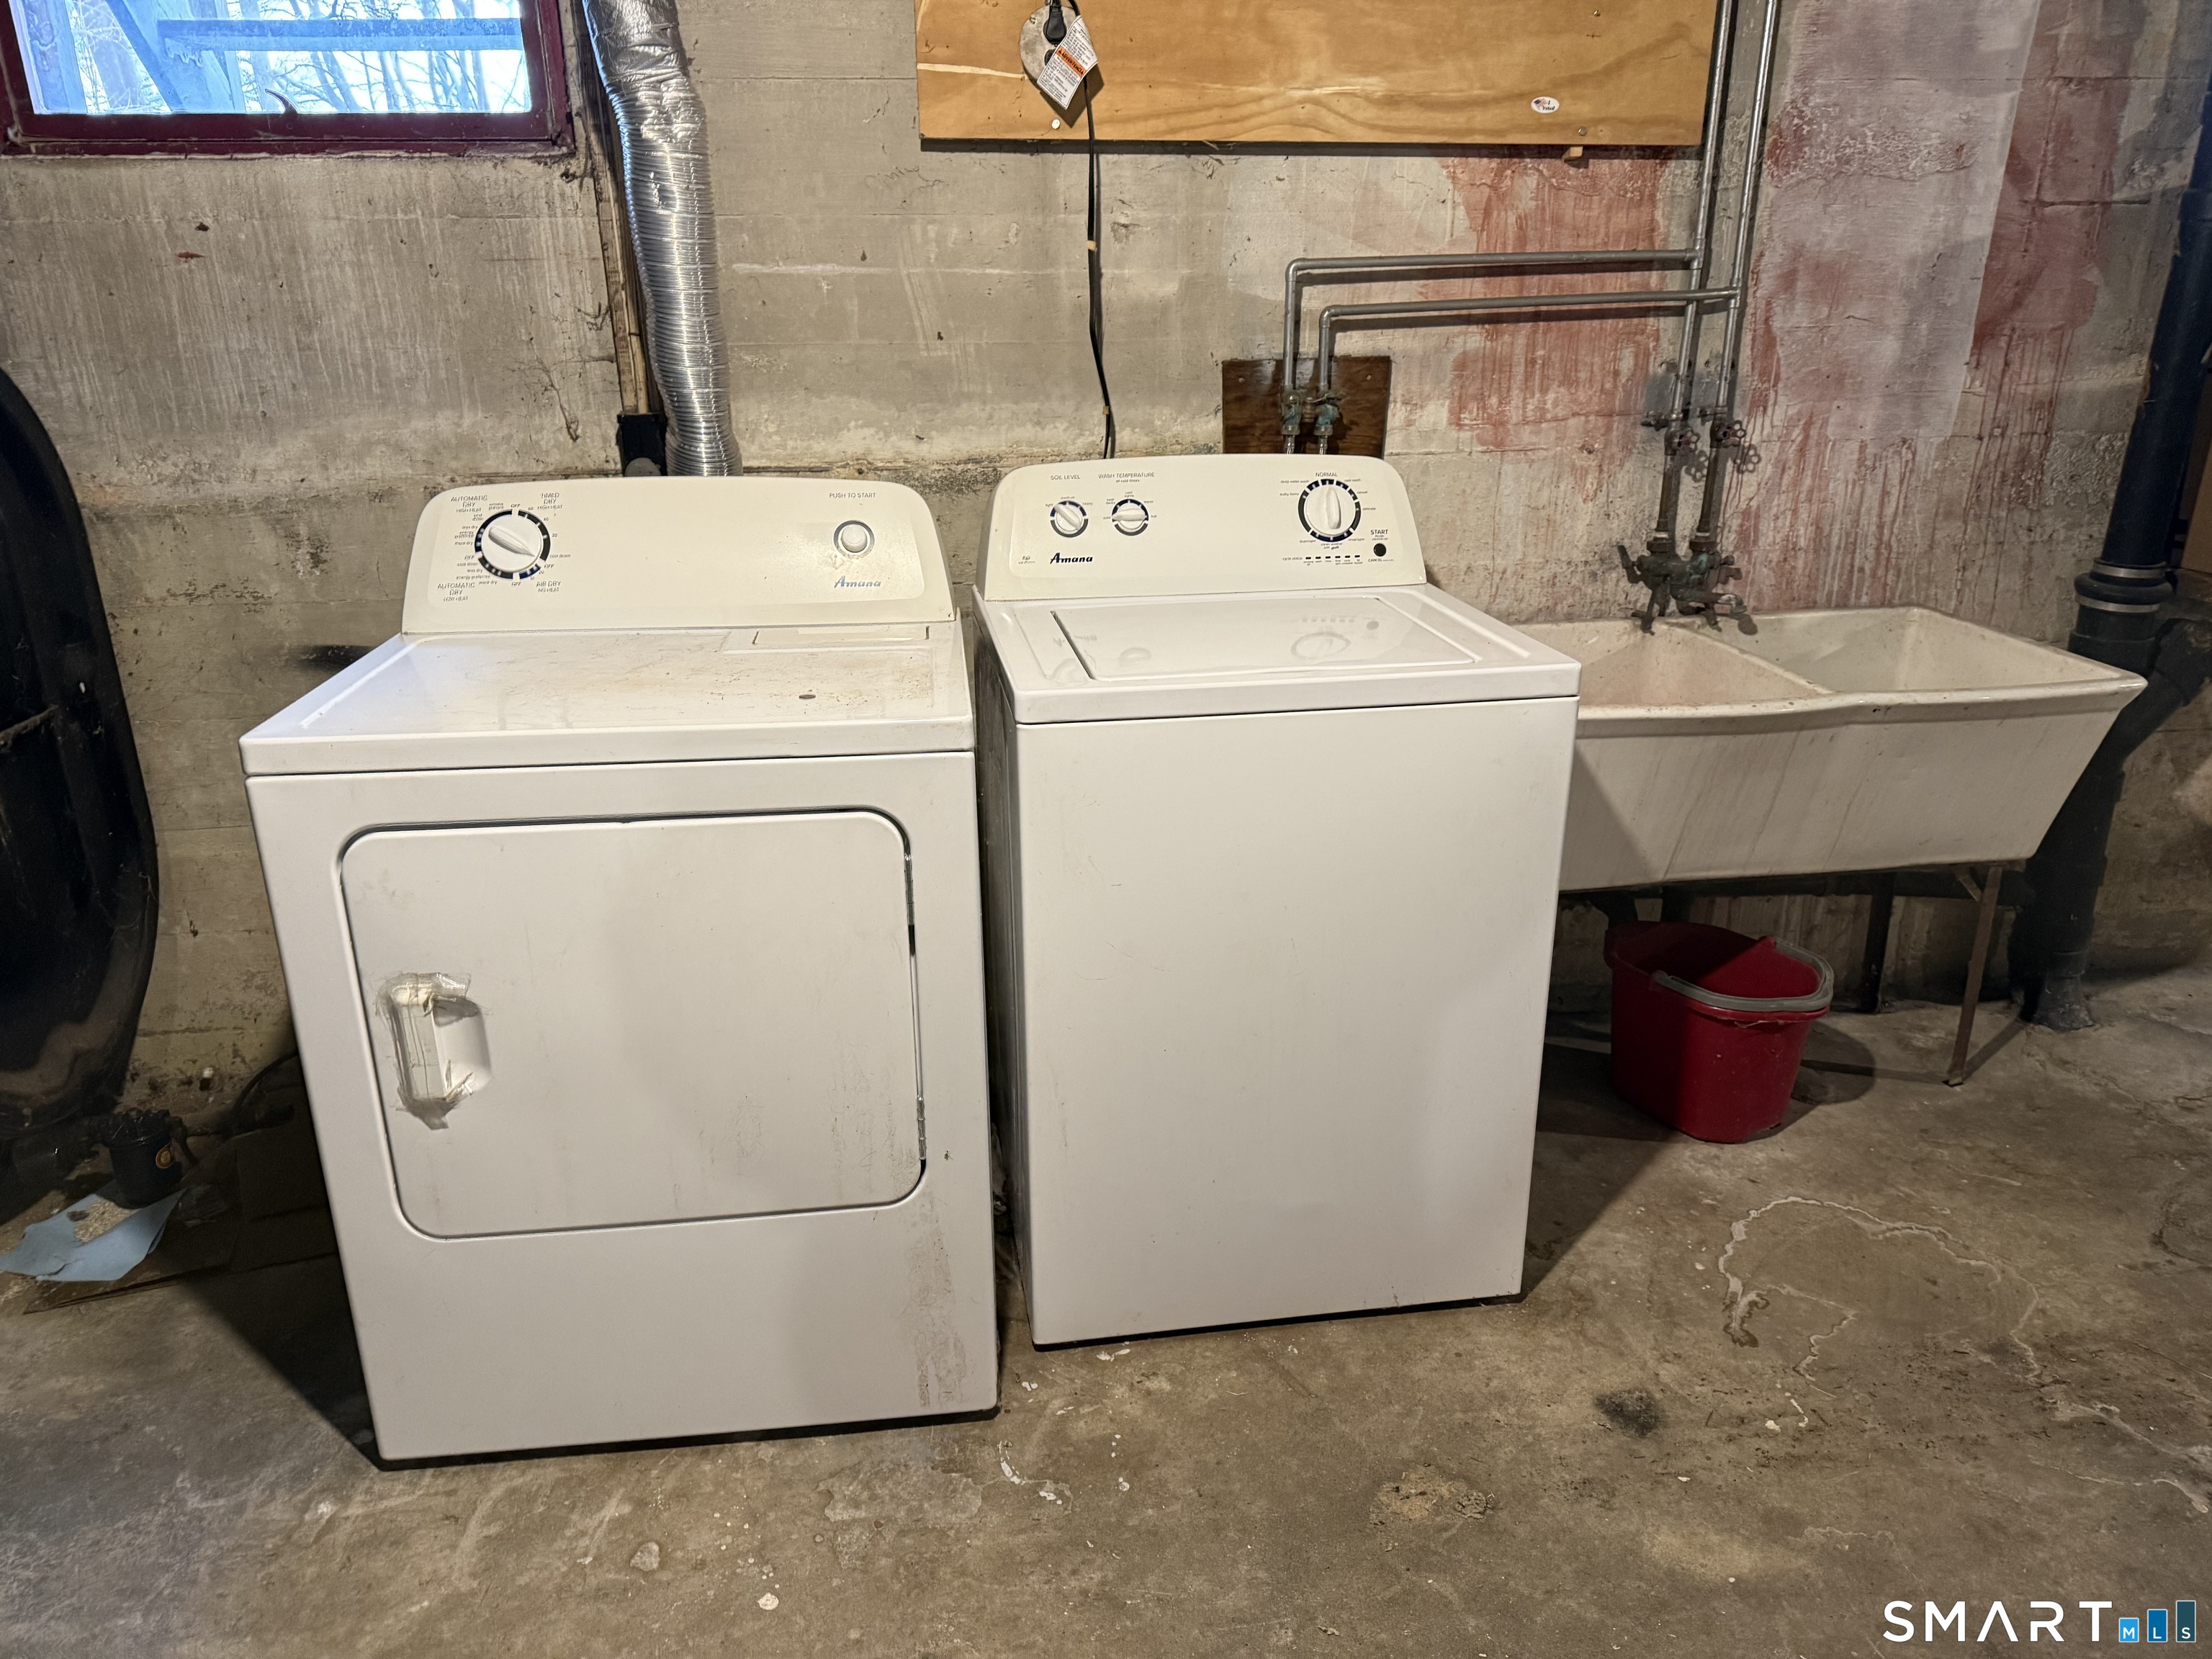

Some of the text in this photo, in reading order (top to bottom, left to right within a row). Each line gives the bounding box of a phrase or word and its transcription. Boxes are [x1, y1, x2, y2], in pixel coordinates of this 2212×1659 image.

[1061, 52, 1084, 75] ADVERTENCIA
[1050, 552, 1094, 565] Amana
[834, 575, 881, 588] Amana
